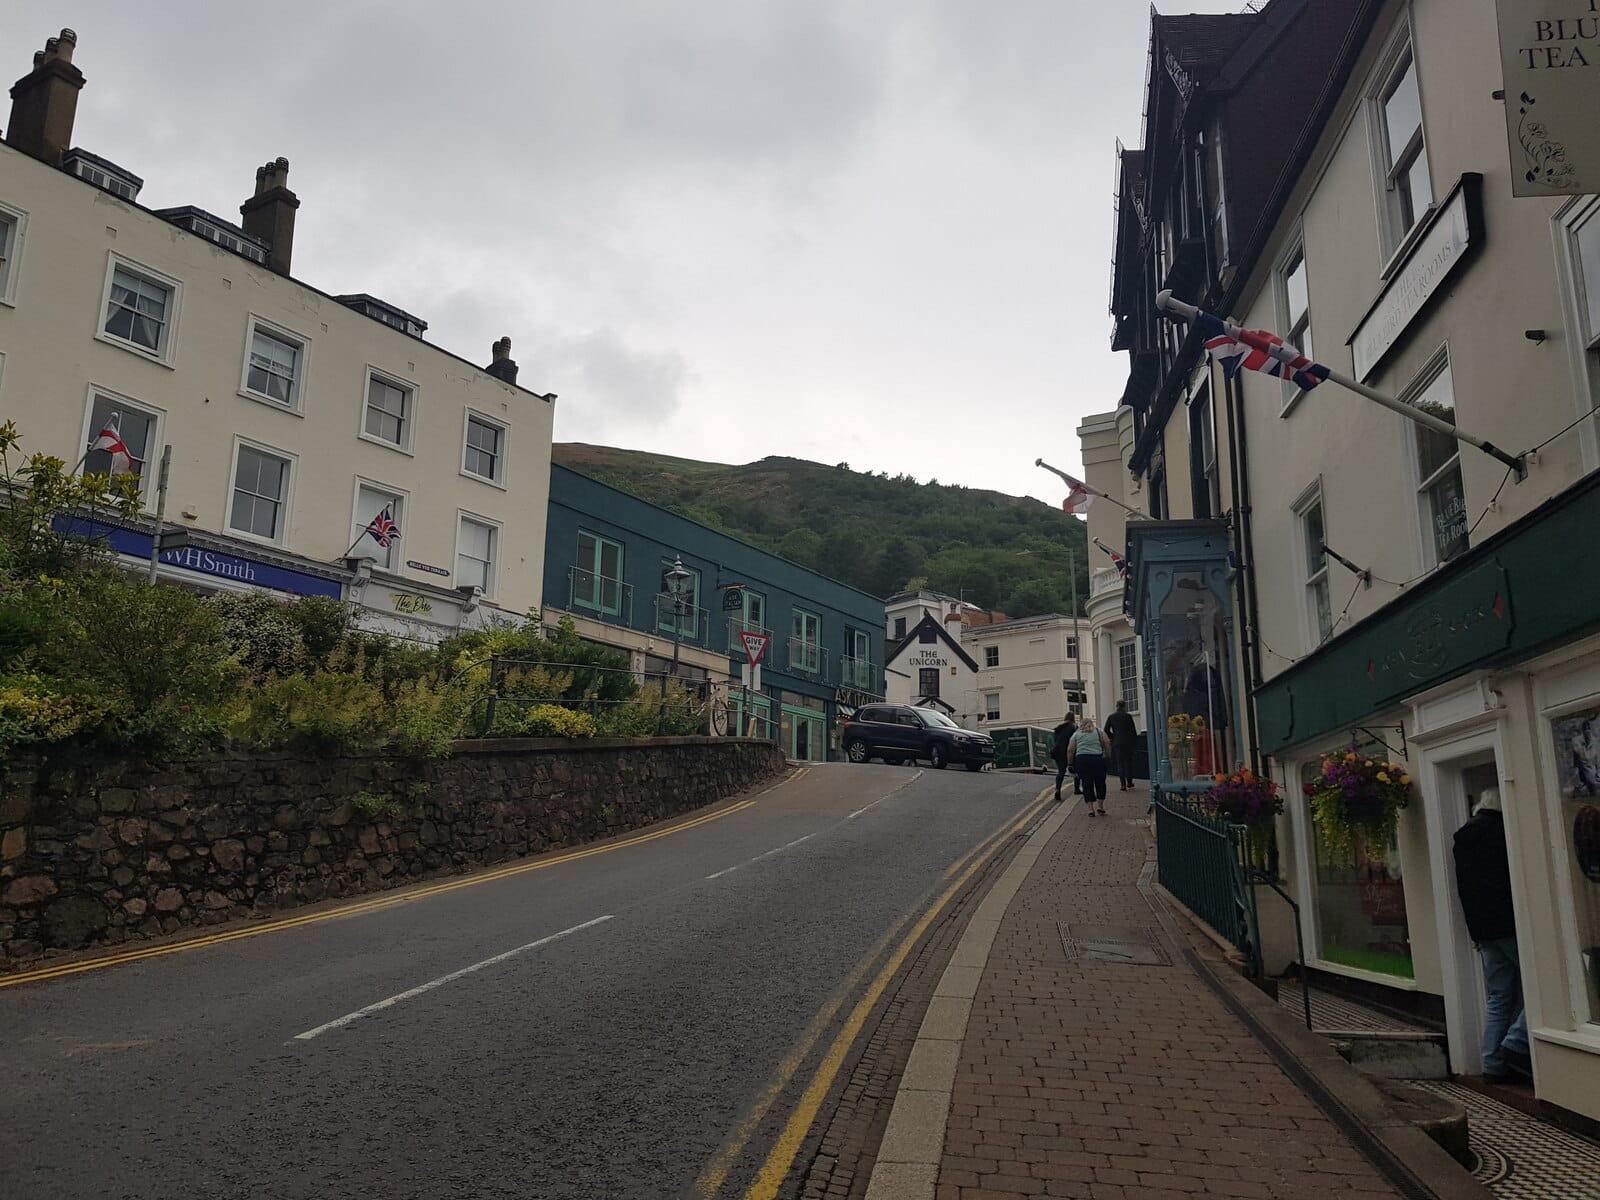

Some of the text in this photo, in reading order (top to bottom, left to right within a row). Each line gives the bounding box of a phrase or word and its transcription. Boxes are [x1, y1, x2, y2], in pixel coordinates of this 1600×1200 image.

[1519, 46, 1590, 69] TEA
[166, 547, 255, 581] WHSmith
[395, 594, 412, 611] The
[745, 636, 762, 646] GIVE
[919, 650, 938, 658] THE
[909, 657, 948, 667] UNICORN
